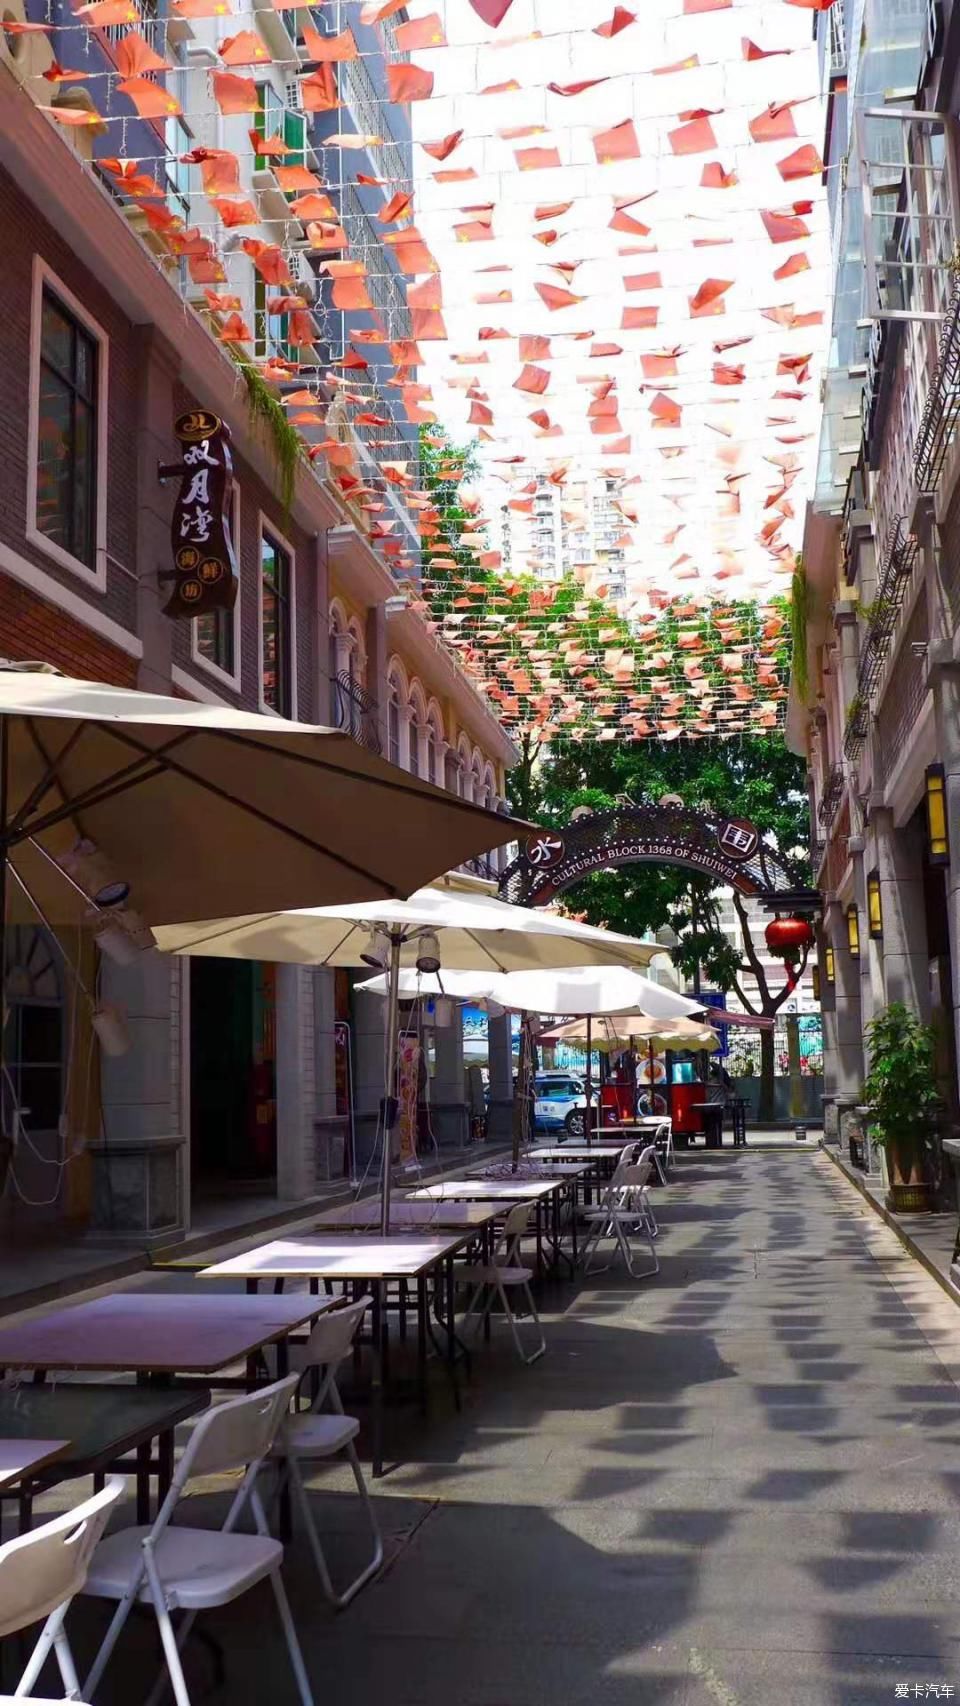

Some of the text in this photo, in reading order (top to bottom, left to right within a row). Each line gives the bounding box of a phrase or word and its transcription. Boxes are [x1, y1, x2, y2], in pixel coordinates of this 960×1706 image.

[181, 440, 220, 542] 双月湾
[531, 823, 755, 864] 水 围
[551, 845, 738, 886] CULTURAL BLOCK 1368 OF SHUIWEI
